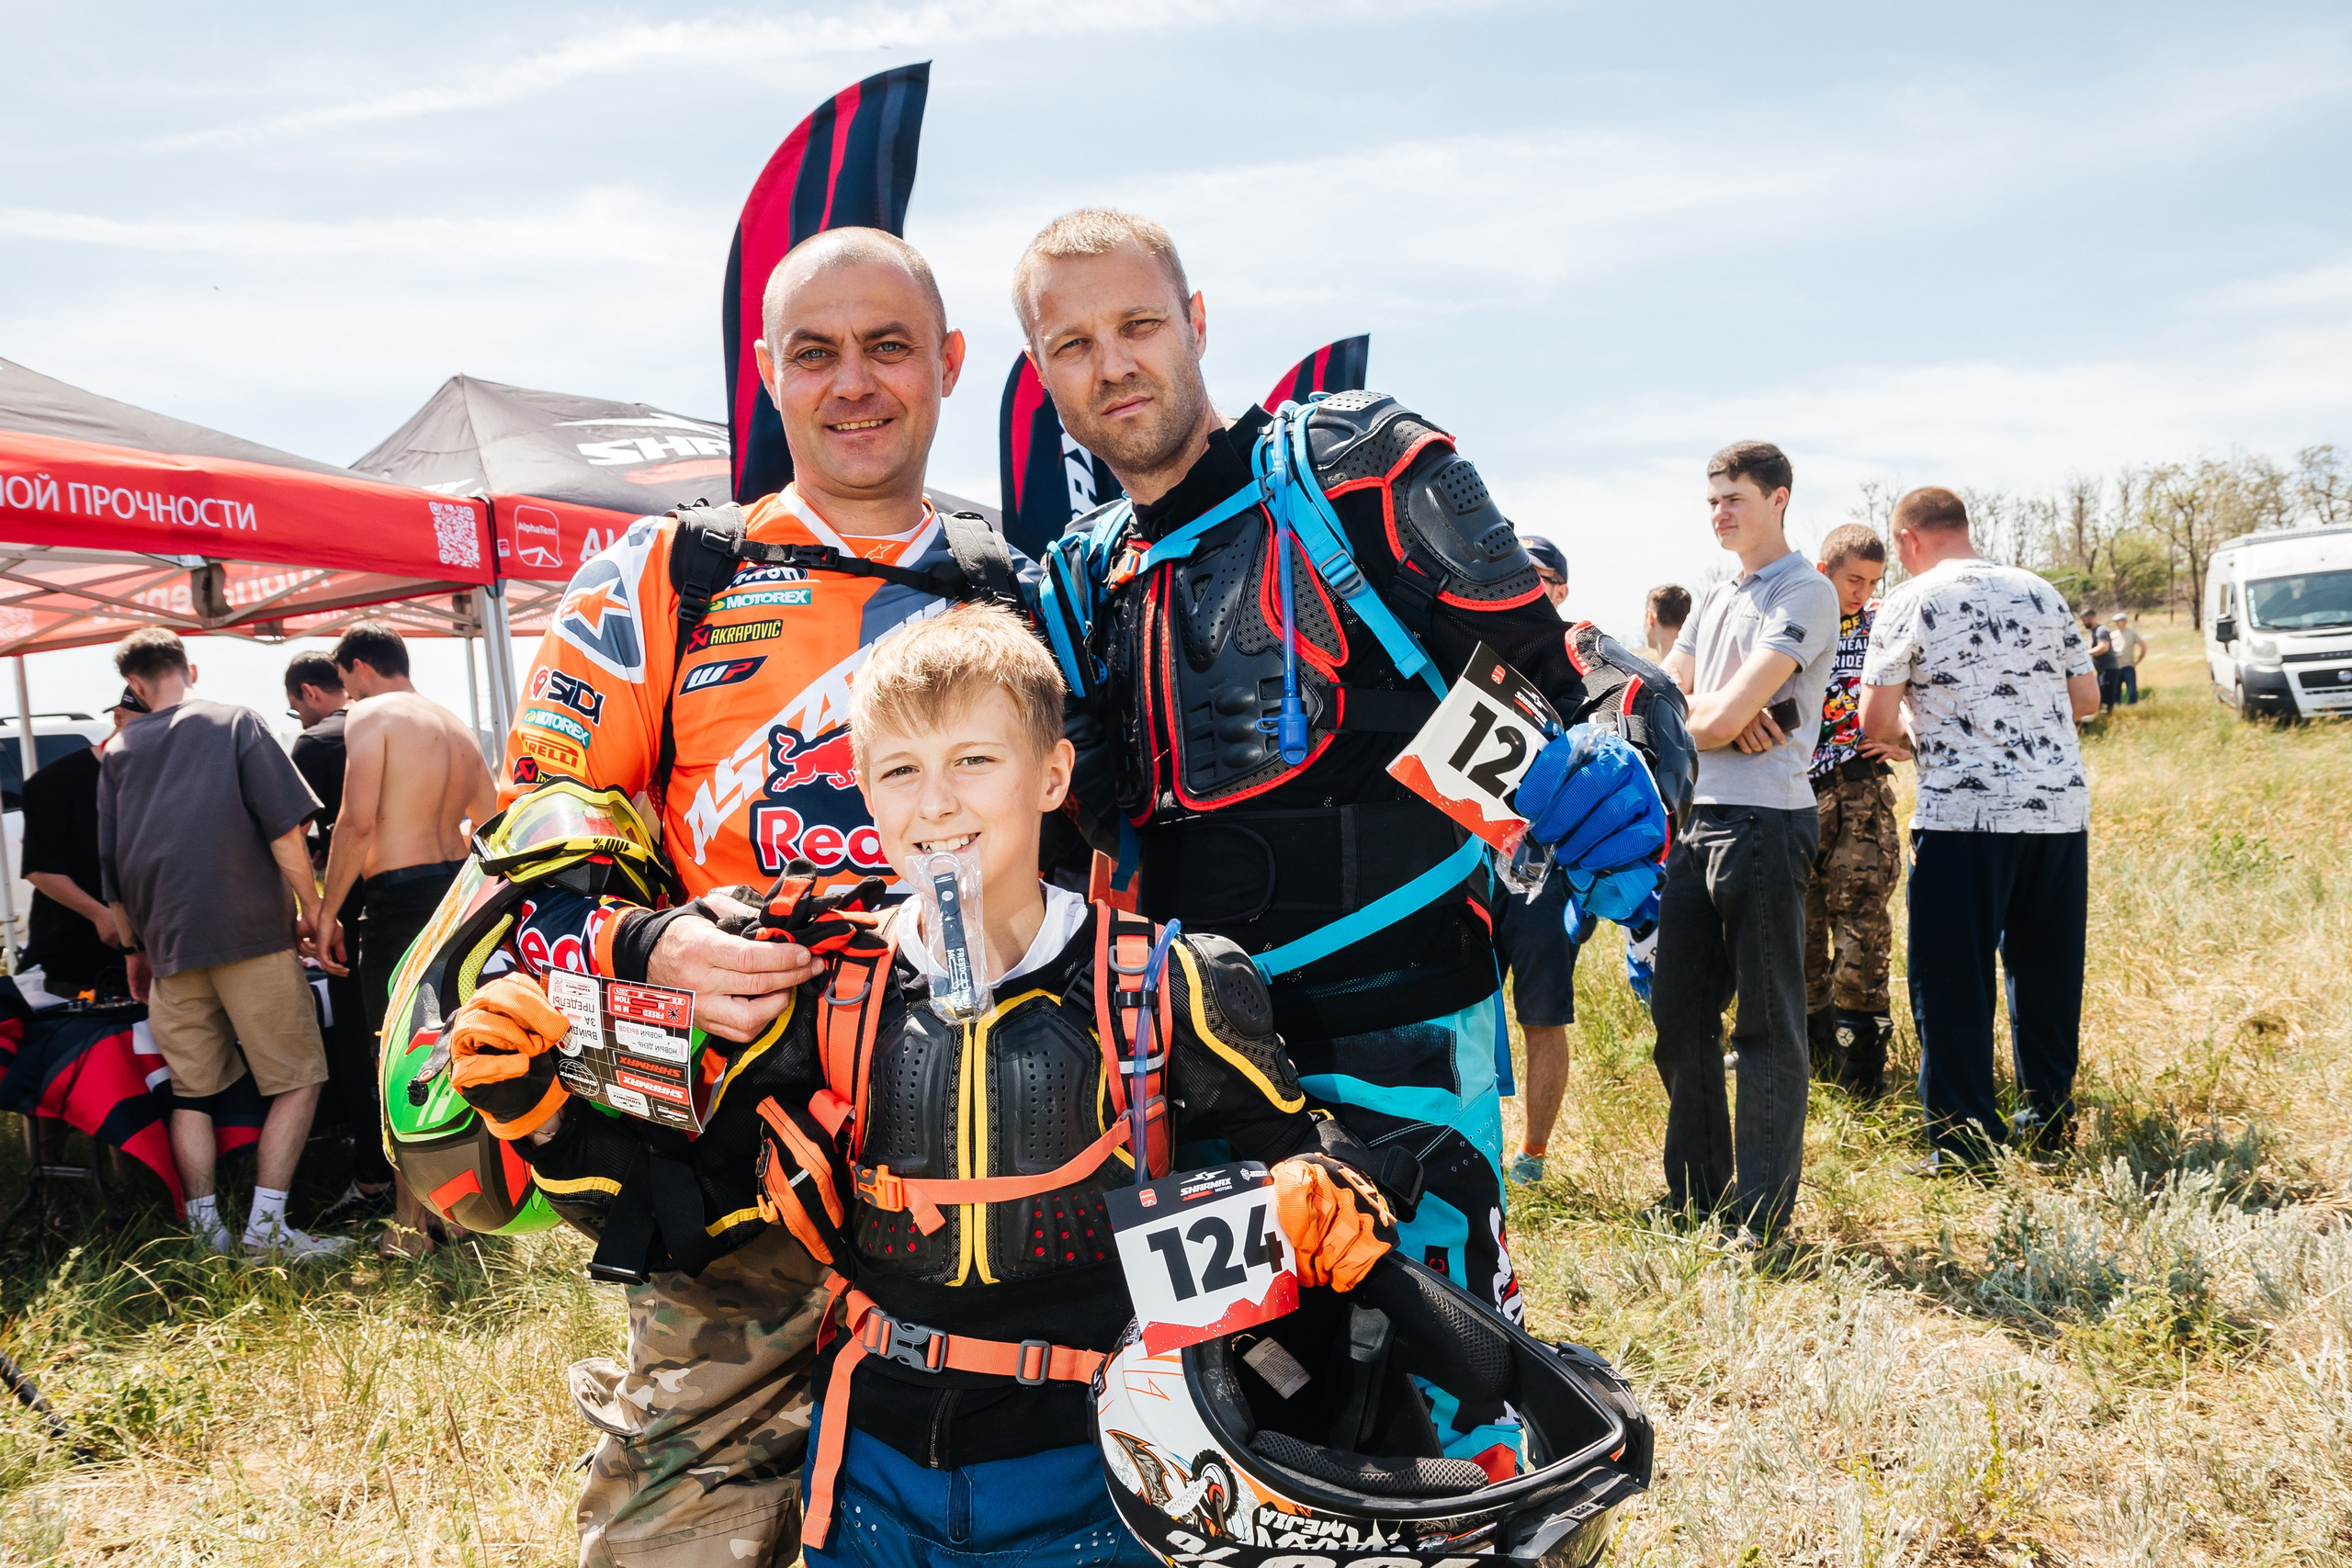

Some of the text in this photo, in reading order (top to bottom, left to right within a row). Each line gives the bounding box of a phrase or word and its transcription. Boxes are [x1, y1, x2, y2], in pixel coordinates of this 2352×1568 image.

[68, 482, 257, 531] ПРОЧНОСТИ
[518, 522, 556, 536] AlphaTent
[727, 590, 808, 609] MOTOREX
[710, 620, 781, 645] AKRAPOVIČ
[686, 661, 754, 689] WP
[547, 670, 604, 727] SIDI
[536, 710, 589, 746] MOTOREX
[553, 995, 595, 1013] ПРЕДЕЛЫ
[584, 1015, 596, 1027] ЗА
[618, 1025, 663, 1040] НОВЫЙ ВЫЗОВ
[639, 1040, 655, 1052] ДЕНЬ
[654, 1043, 678, 1055] НОВЫЙ
[618, 1055, 683, 1077] SHARMAX
[622, 1076, 684, 1099] SHARMAX
[1180, 1178, 1232, 1197] SHARMAX
[1215, 1185, 1233, 1193] MOTORS
[1145, 1203, 1284, 1303] 124
[1259, 1506, 1346, 1538] MEJIA
